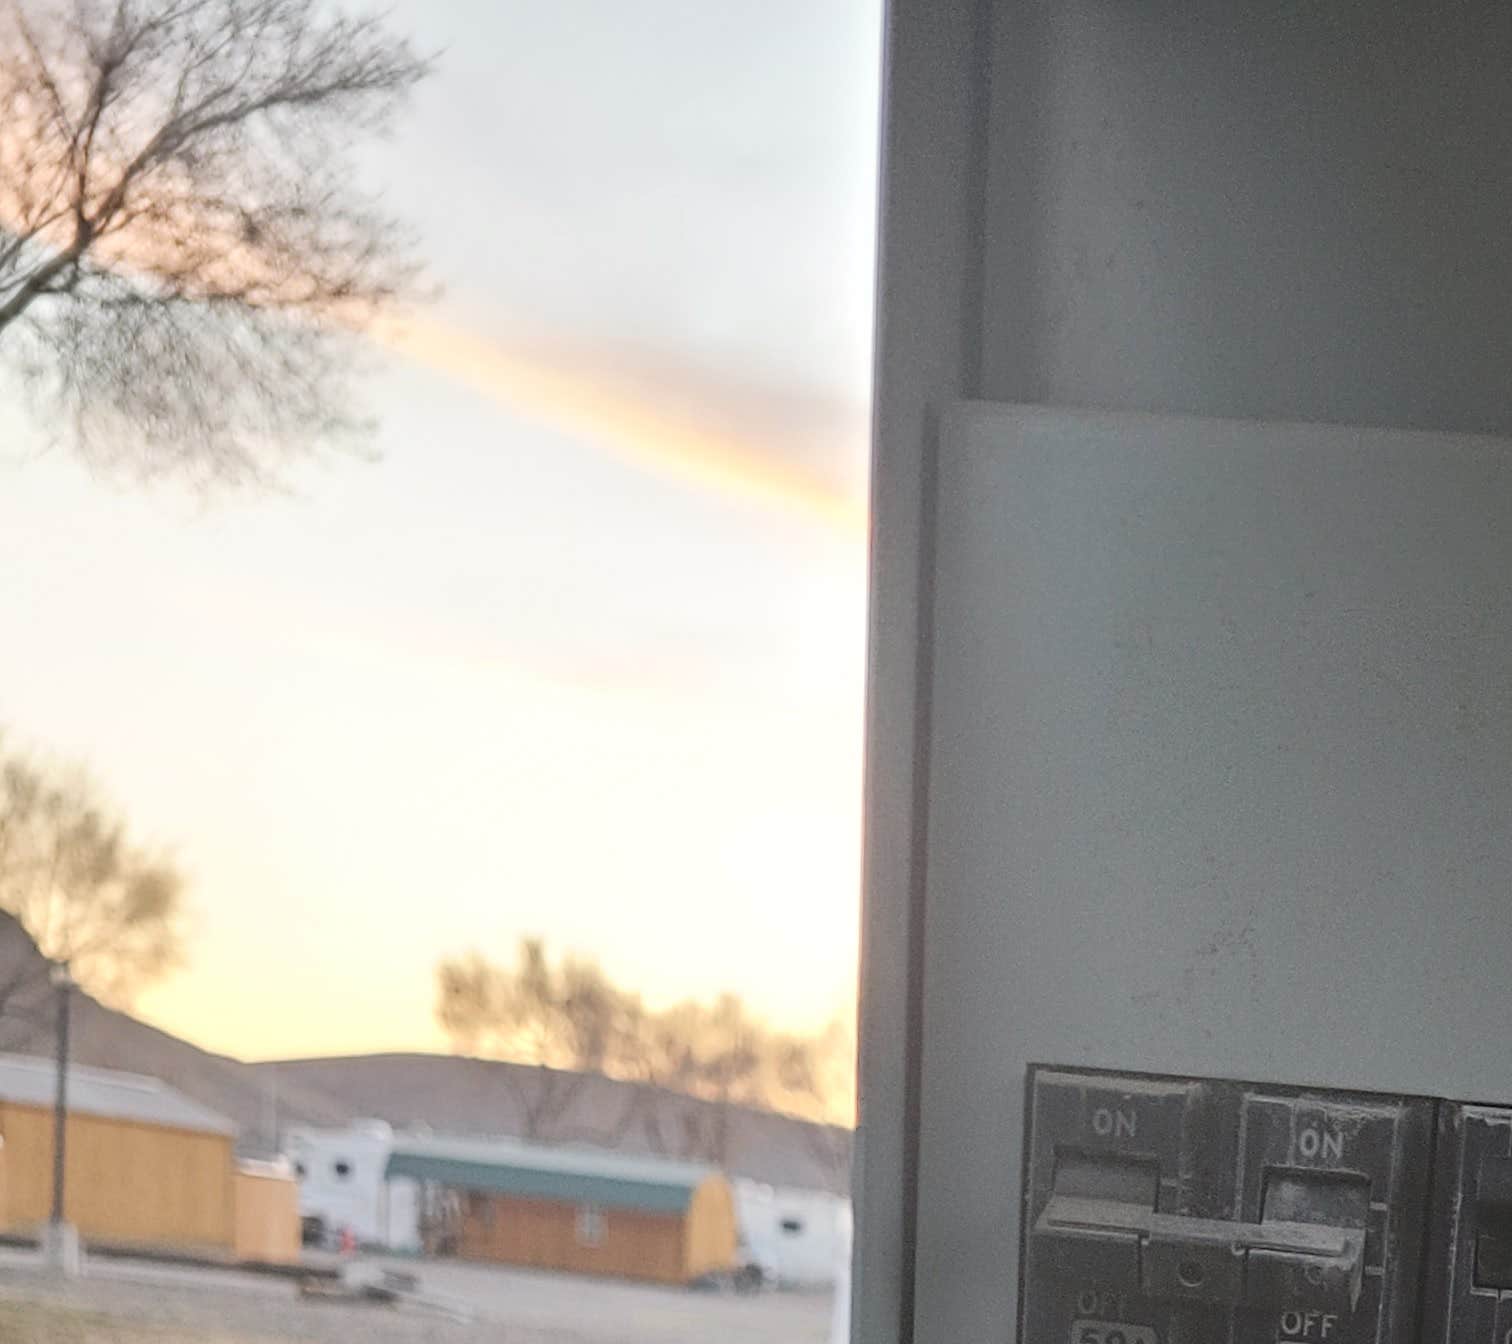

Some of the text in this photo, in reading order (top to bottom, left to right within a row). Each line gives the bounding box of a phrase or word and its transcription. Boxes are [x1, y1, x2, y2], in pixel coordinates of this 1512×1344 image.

[1092, 1109, 1137, 1137] ON
[1300, 1128, 1345, 1159] ON
[1280, 1311, 1338, 1339] OFF
